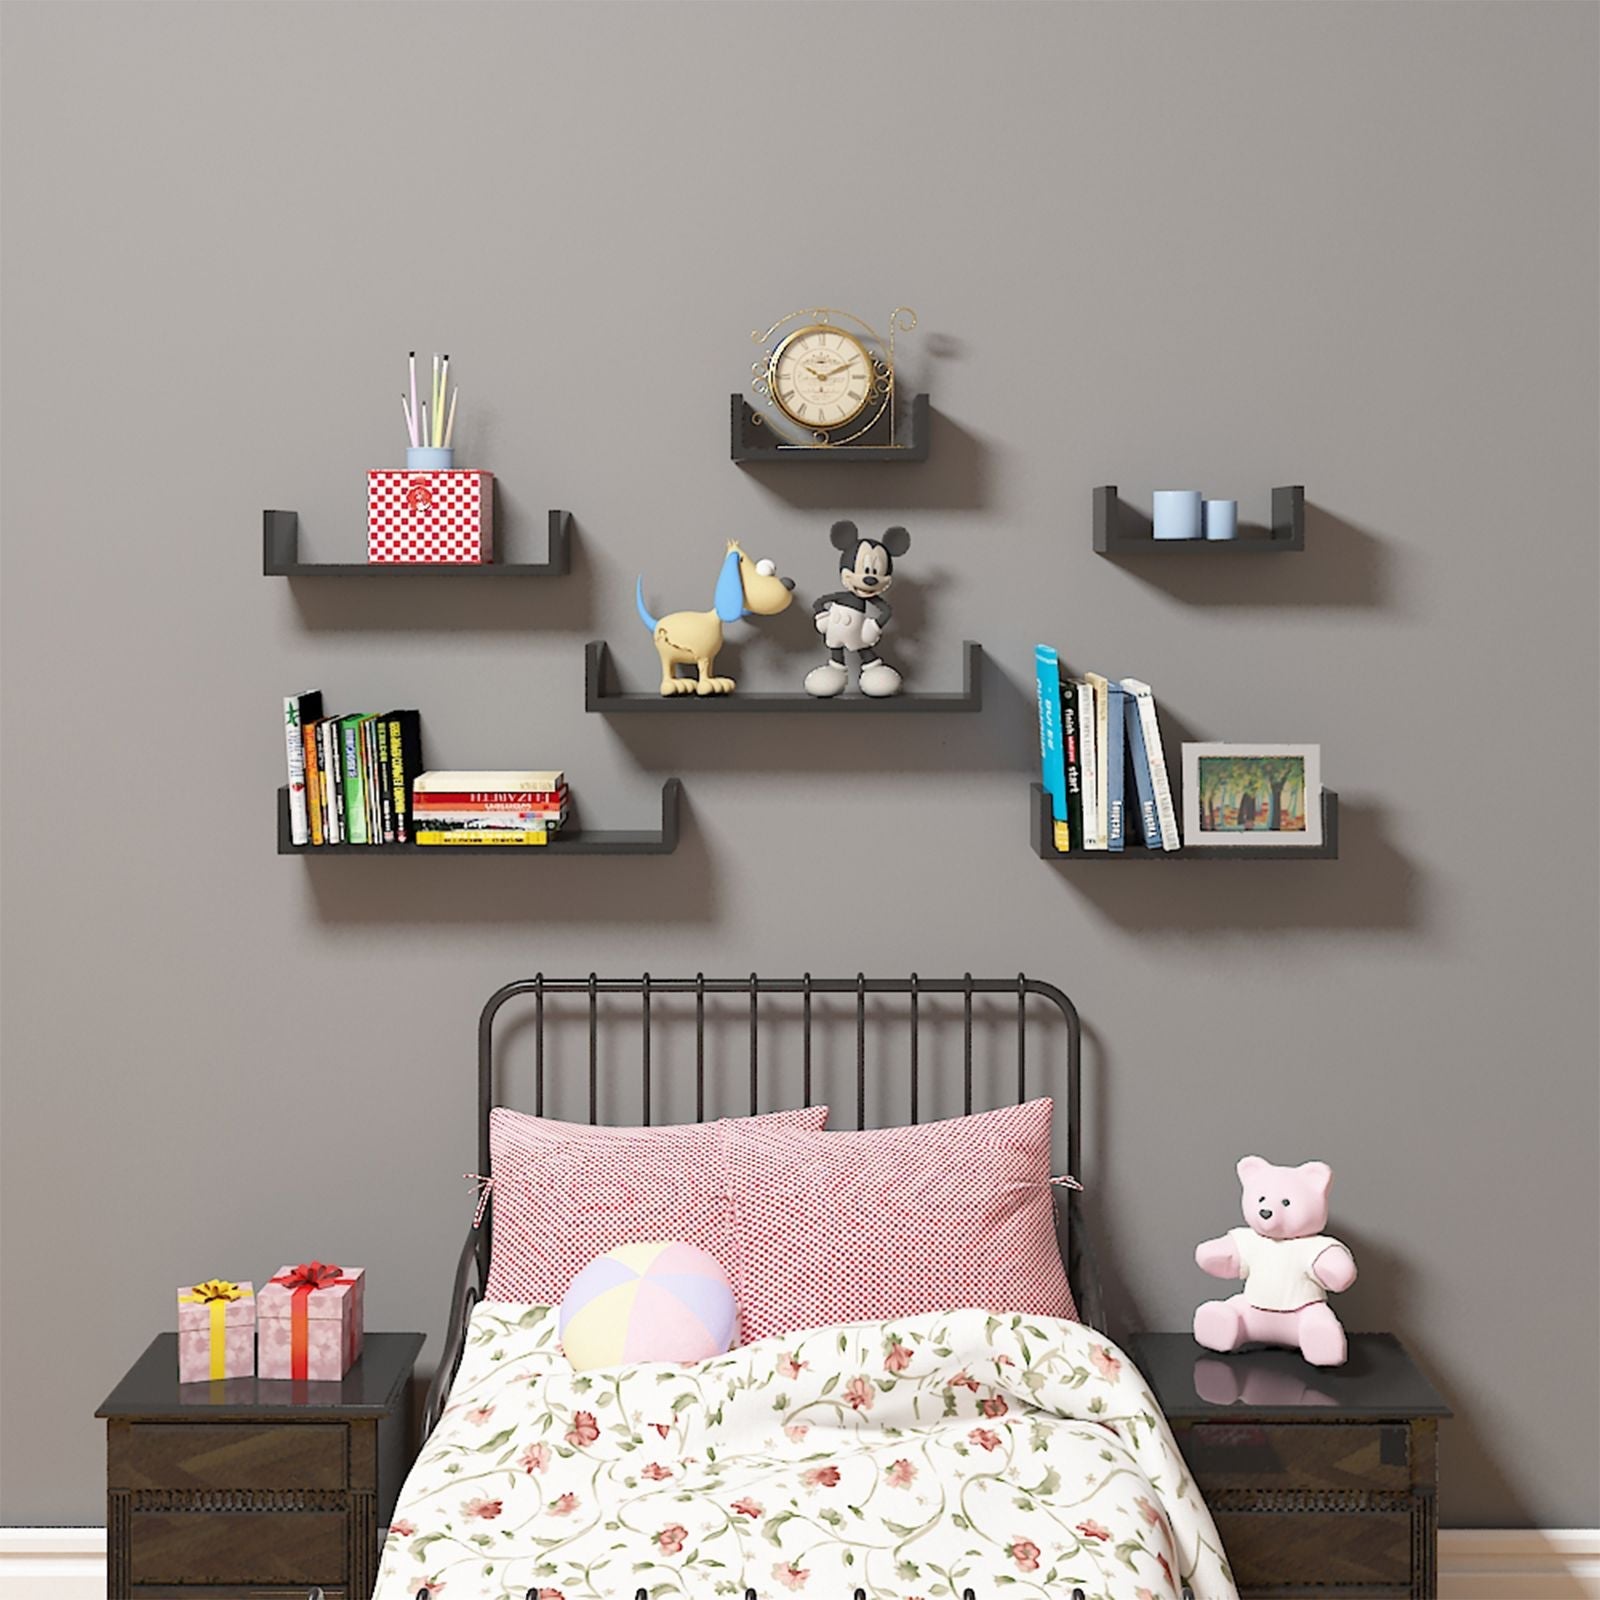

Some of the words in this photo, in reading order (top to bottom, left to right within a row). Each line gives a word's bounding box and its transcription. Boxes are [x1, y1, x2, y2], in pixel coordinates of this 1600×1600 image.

[1065, 708, 1075, 736] finish
[1068, 766, 1080, 794] start
[470, 793, 550, 803] ELIZABETH
